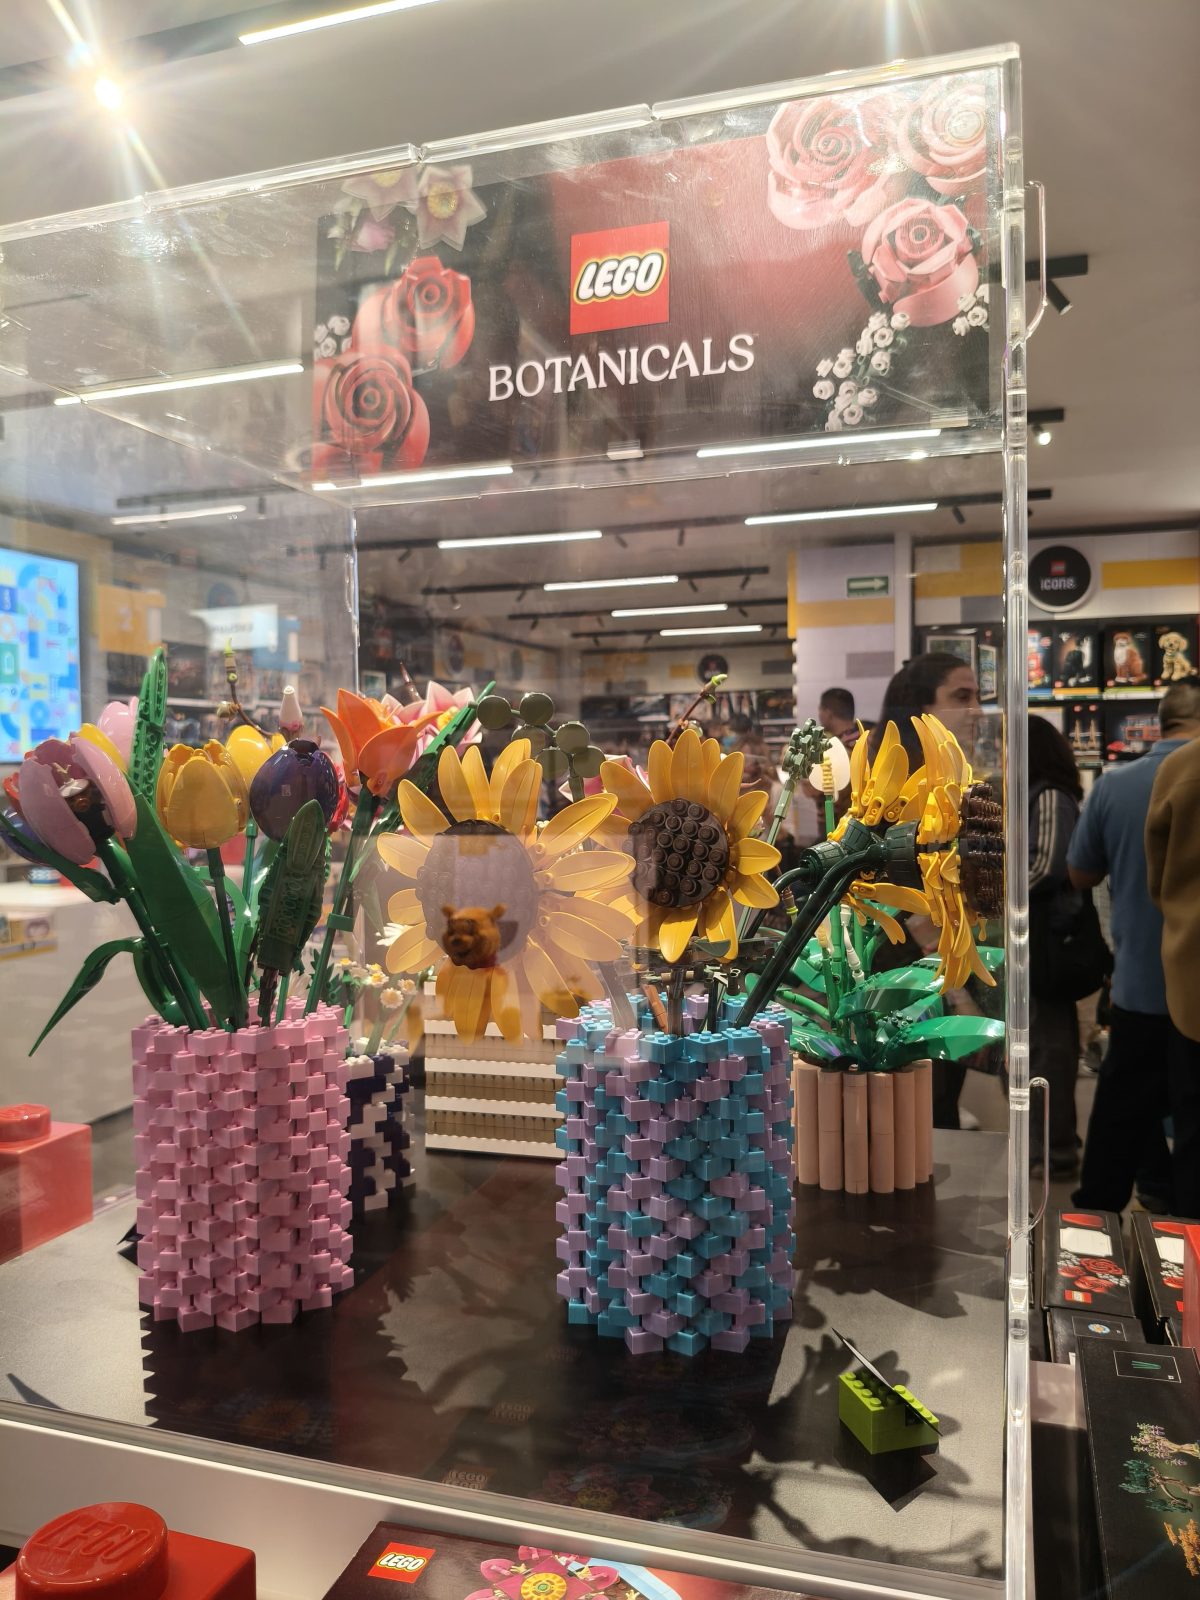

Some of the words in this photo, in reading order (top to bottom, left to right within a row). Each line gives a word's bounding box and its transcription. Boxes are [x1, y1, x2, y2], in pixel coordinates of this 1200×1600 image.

[575, 250, 666, 302] LEGO
[488, 334, 755, 402] BOTANICALS
[1040, 577, 1074, 591] icons
[33, 1514, 150, 1564] LEGO
[378, 1552, 426, 1571] LEGO
